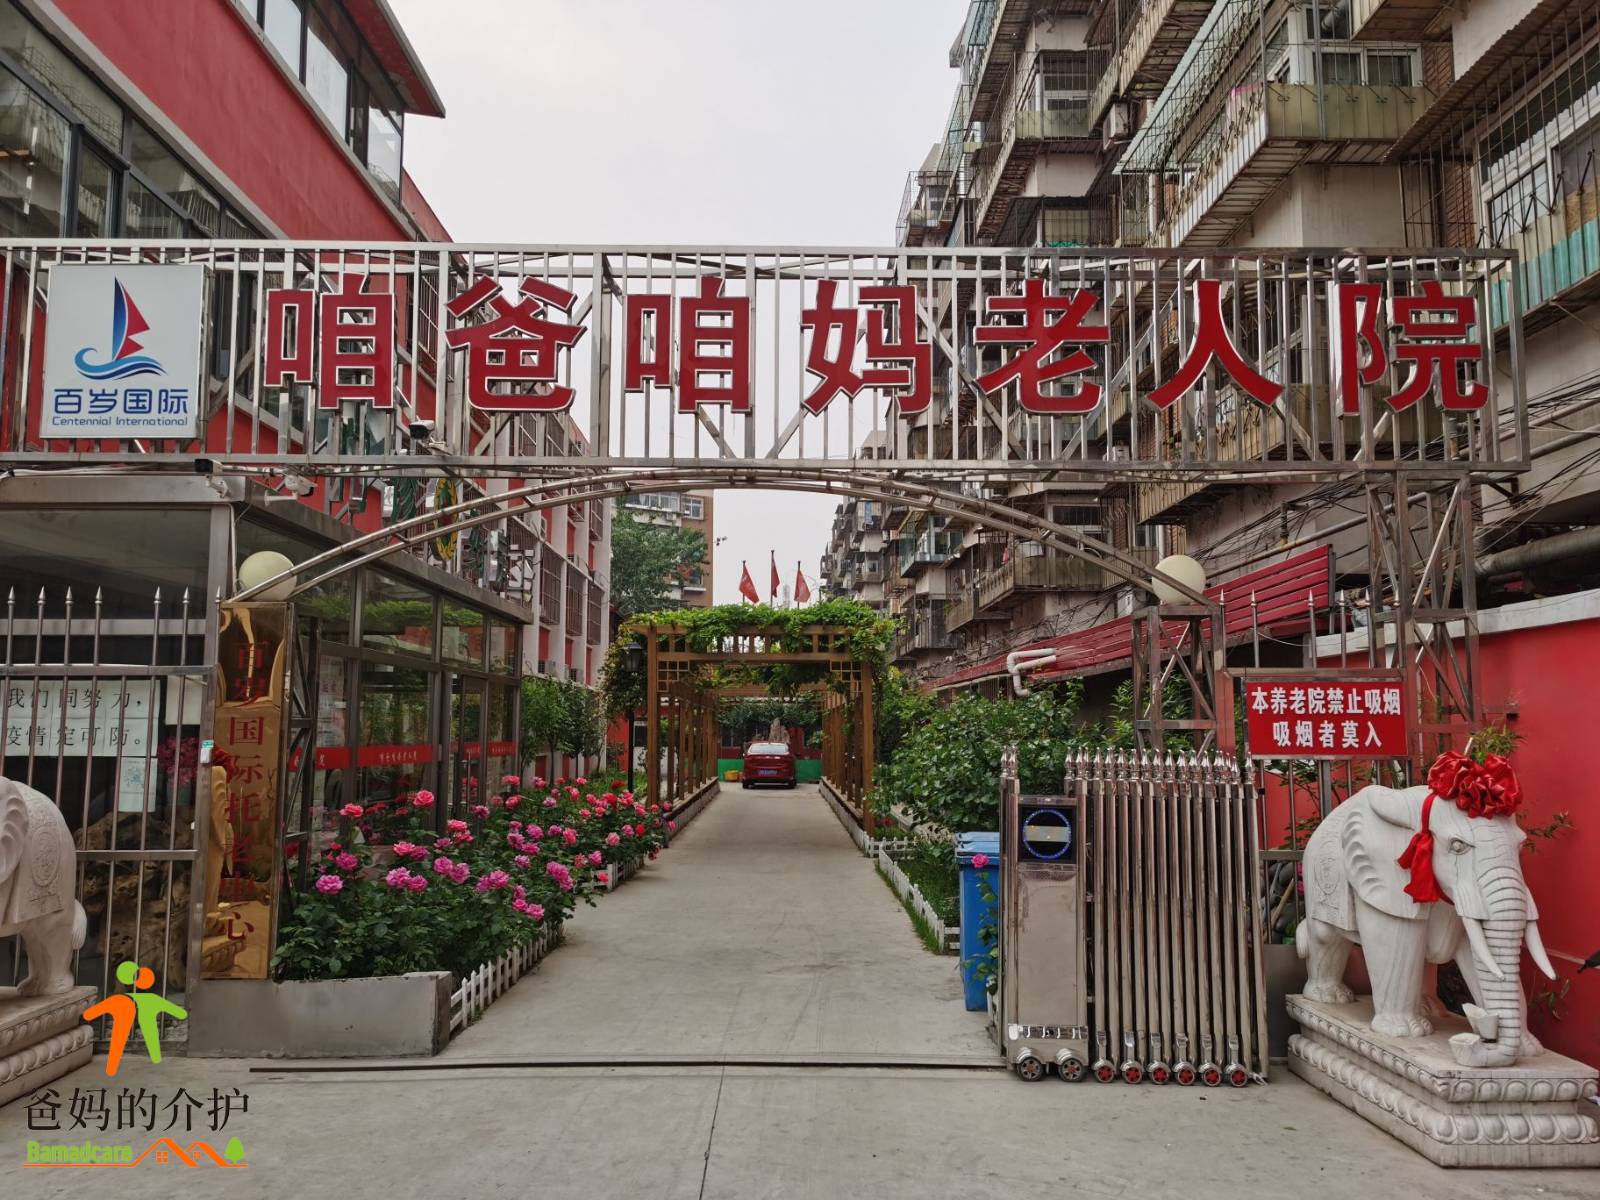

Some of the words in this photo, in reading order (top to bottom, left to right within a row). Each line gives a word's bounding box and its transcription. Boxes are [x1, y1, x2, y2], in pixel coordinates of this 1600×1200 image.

[263, 272, 1488, 416] 咱爸咱妈老人院
[54, 388, 189, 415] 百岁国际
[52, 416, 112, 426] Centennial
[116, 416, 188, 426] International
[1251, 686, 1401, 716] 本养老院禁止吸烟
[1272, 720, 1382, 748] 吸烟者莫入
